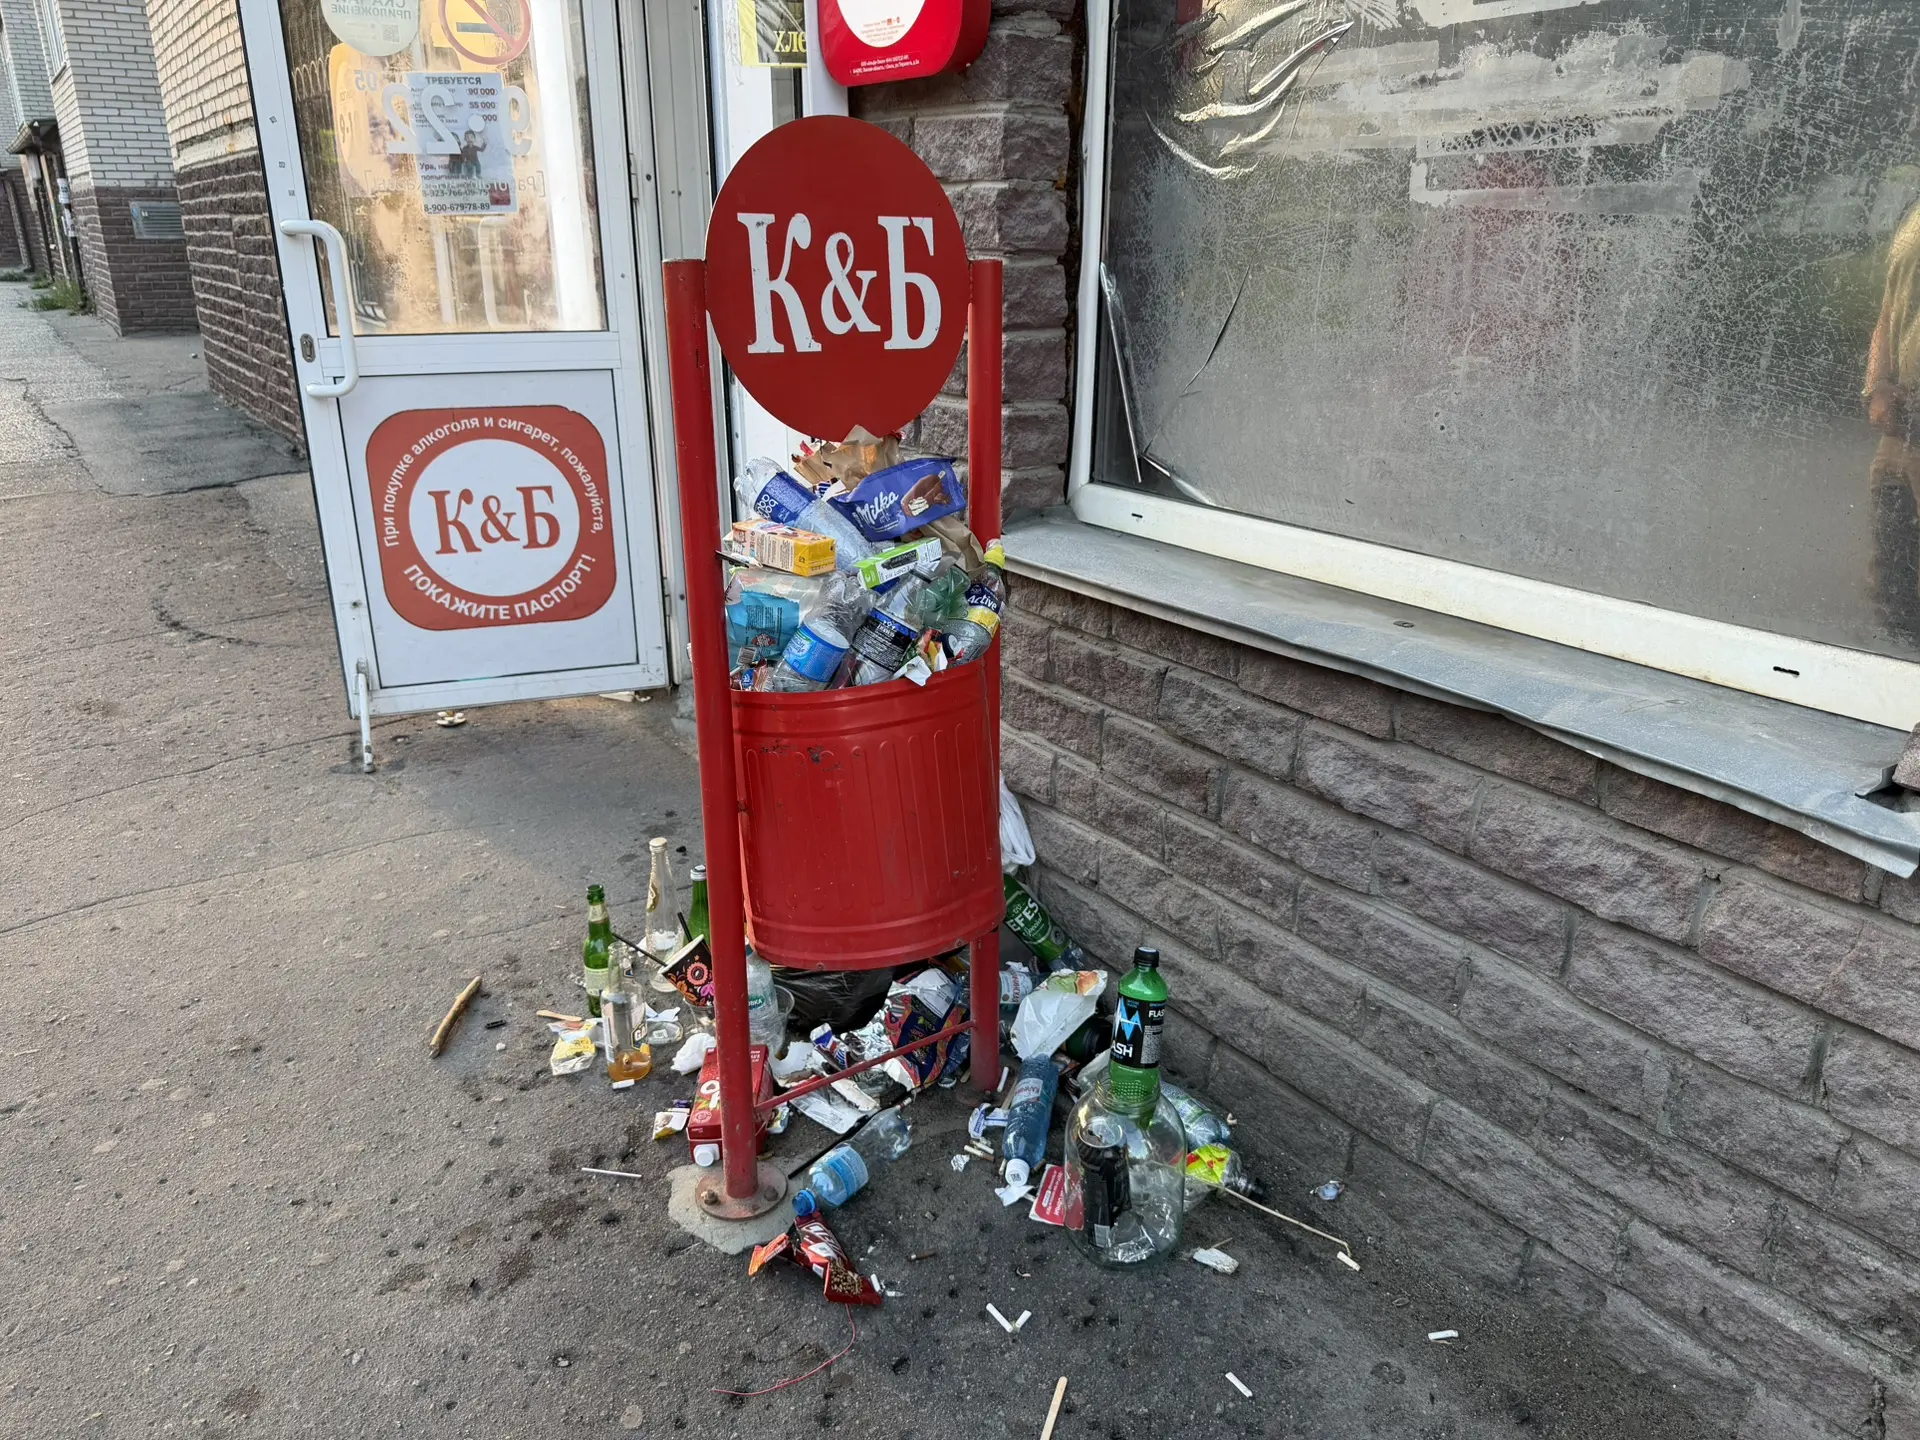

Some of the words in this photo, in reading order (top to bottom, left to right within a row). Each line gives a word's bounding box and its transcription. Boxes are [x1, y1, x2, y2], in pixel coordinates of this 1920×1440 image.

[425, 76, 482, 85] ТРЕБУЕТСЯ
[737, 212, 942, 354] К&Б
[383, 453, 414, 513] покупке
[411, 417, 480, 456] алкоголя
[483, 417, 494, 428] и
[498, 416, 559, 452] сигарет,
[560, 447, 604, 534] пожалуйста,
[427, 485, 561, 555] К&Б
[859, 489, 899, 524] Milka
[403, 564, 511, 620] ПОКАЖИТЕ
[513, 554, 596, 619] ПАСПОРТ!
[966, 592, 998, 611] Active
[1006, 897, 1040, 932] EFES
